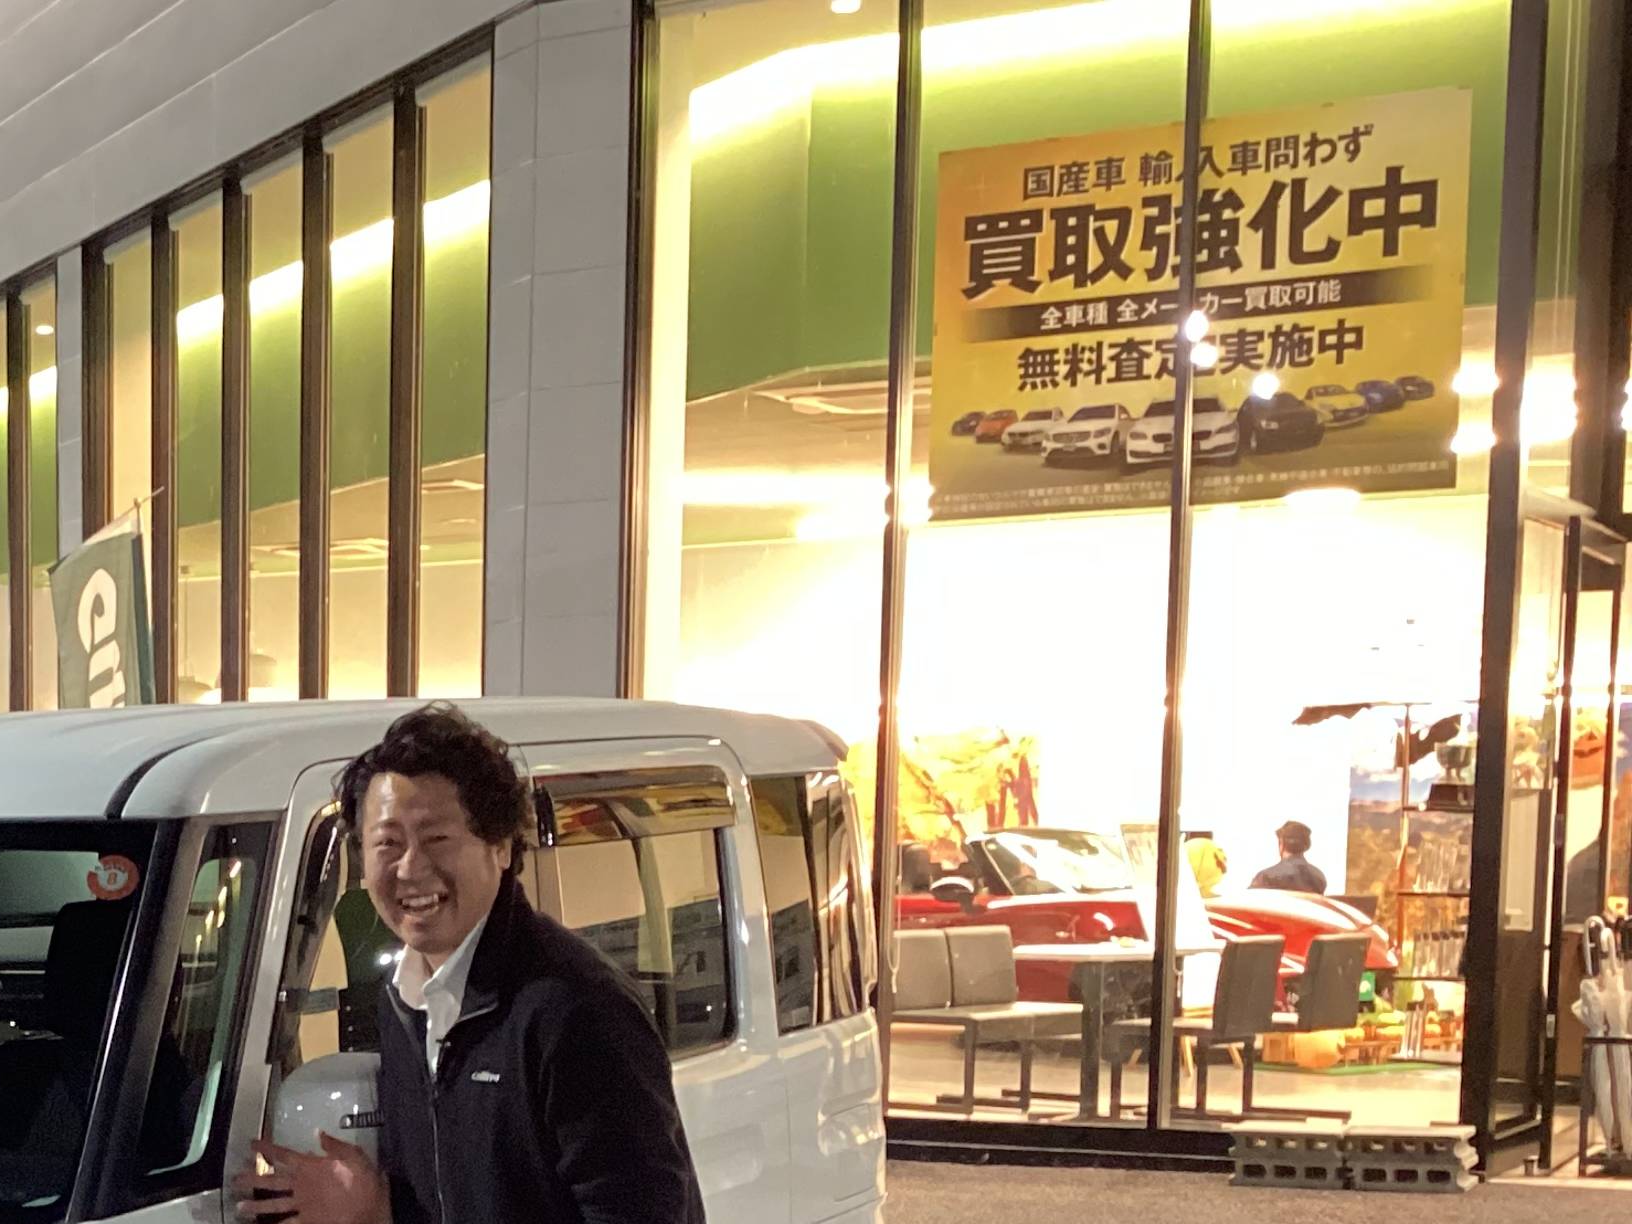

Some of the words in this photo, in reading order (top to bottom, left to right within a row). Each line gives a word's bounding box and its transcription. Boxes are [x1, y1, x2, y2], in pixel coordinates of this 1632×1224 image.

[1023, 155, 1126, 200] 国産車
[961, 165, 1439, 299] 買取強化中
[1040, 302, 1108, 331] 全車種
